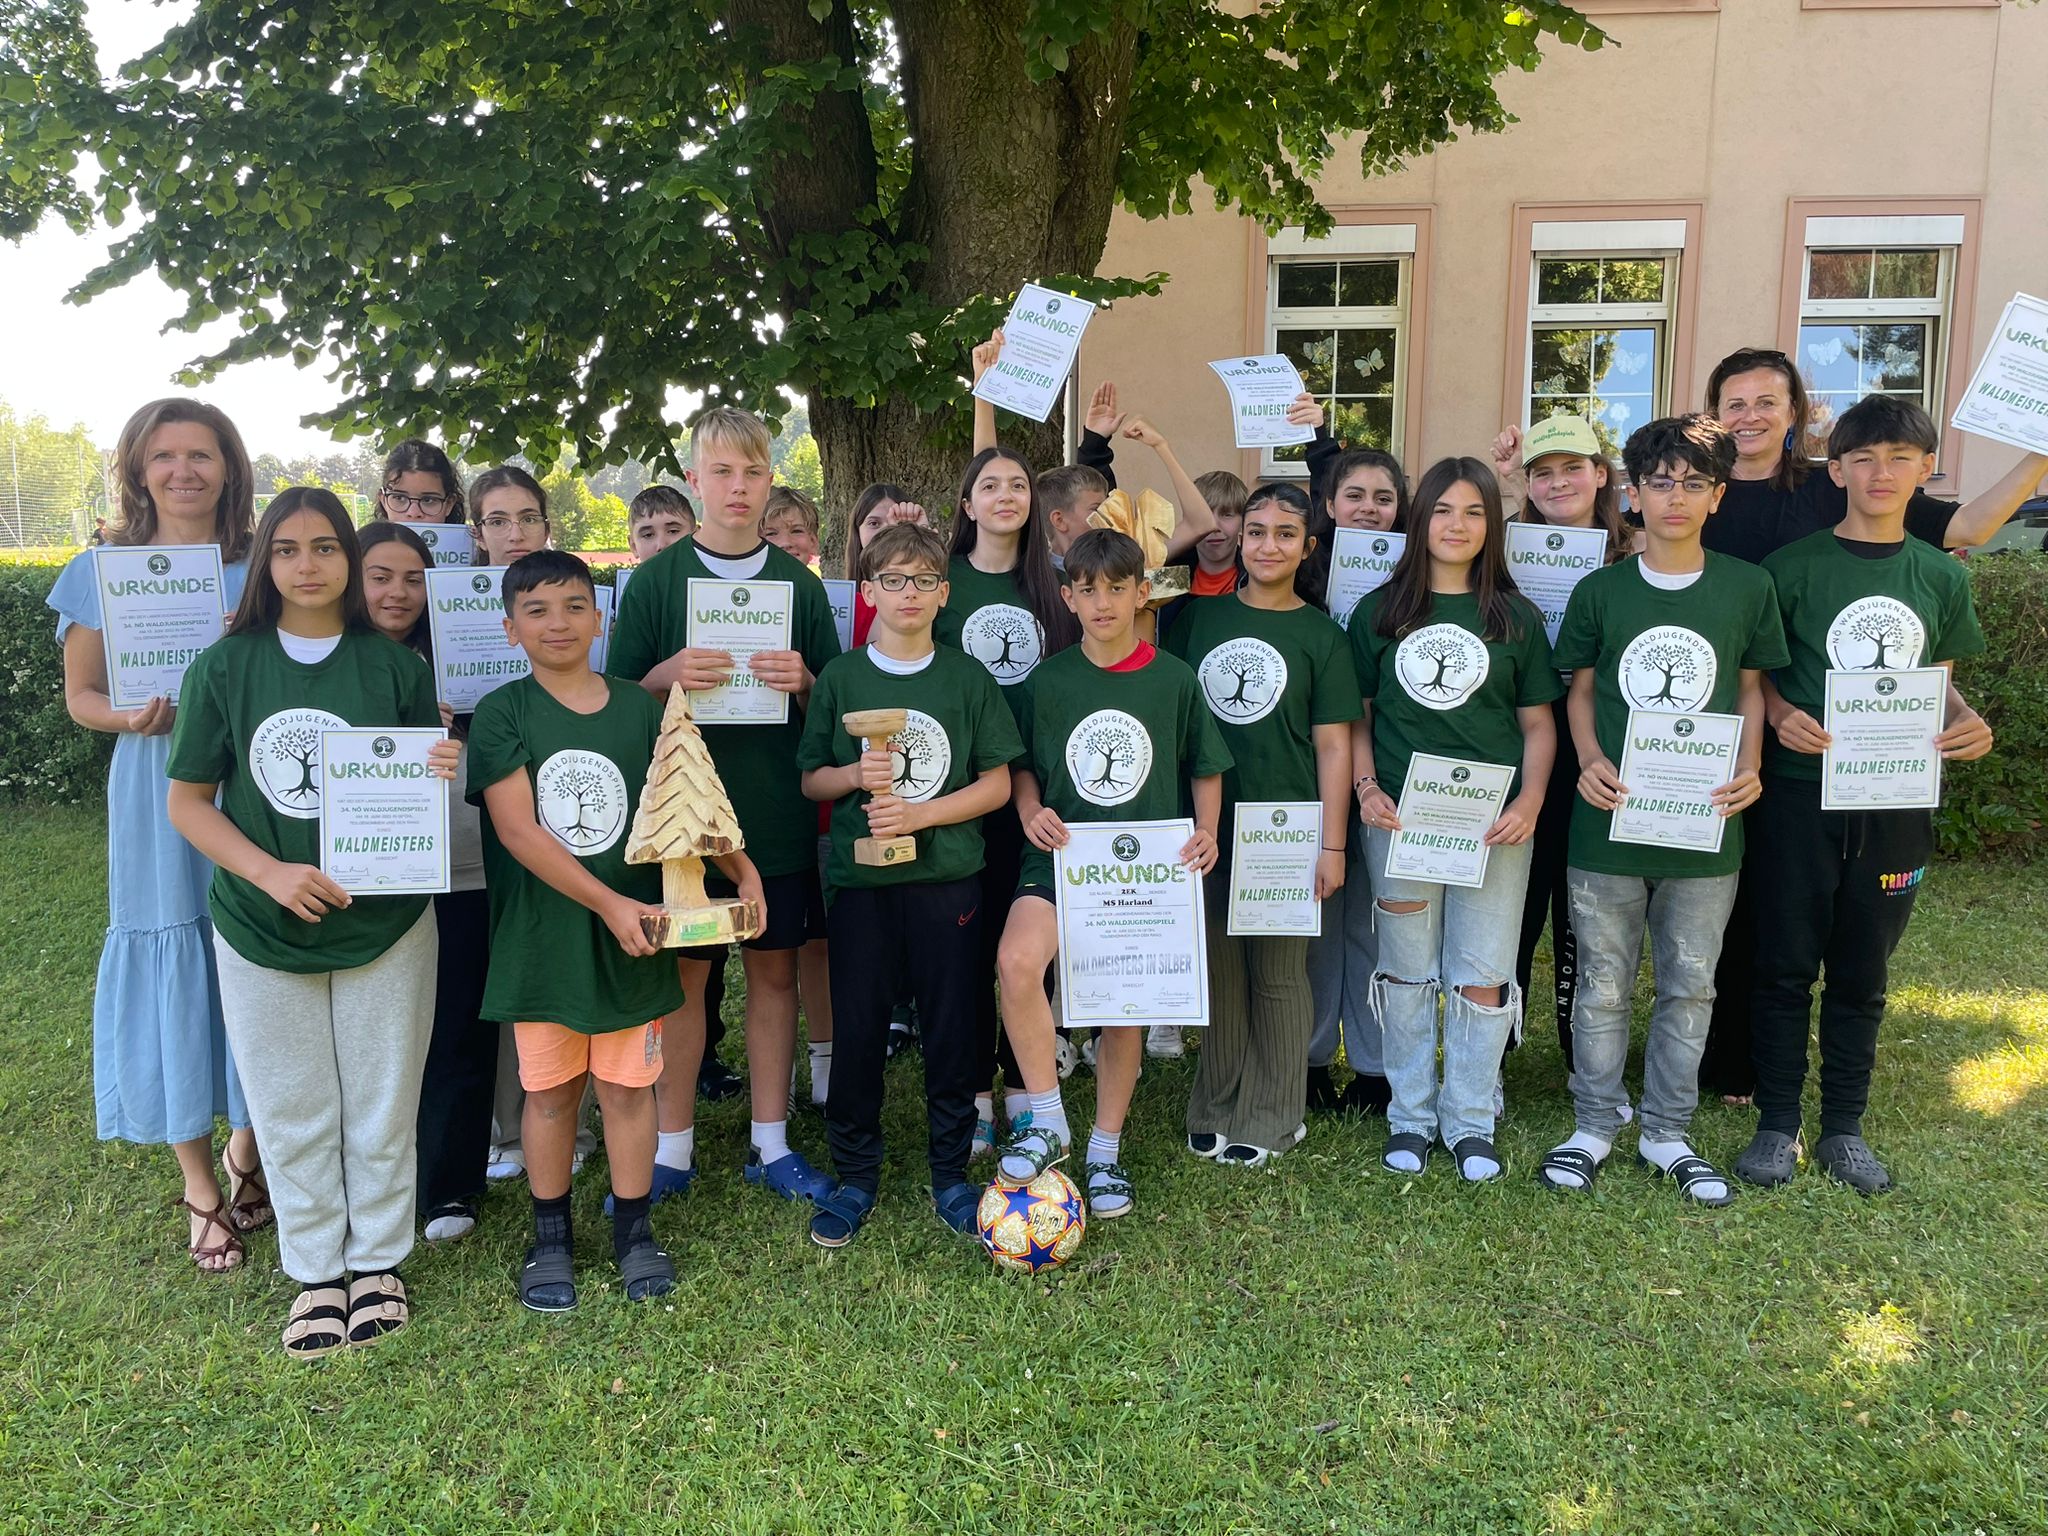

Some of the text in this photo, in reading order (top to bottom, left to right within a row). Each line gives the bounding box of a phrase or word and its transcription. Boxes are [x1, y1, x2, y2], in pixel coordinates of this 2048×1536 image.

[1016, 308, 1079, 337] URKUNDE
[995, 360, 1054, 389] WALDMEISTERS
[1224, 365, 1290, 376] URKUNDE
[1512, 551, 1597, 570] URKUNDE
[108, 578, 215, 596] URKUNDE
[696, 609, 784, 625] URKUNDE
[1840, 601, 1920, 649] WALDJUGENDSPIELE
[1408, 628, 1484, 670] WALDJUGENDSPIELE
[1631, 632, 1713, 678] WALDJUGENDSPIELE
[447, 659, 528, 677] WALDMEISTERS
[1211, 642, 1282, 685] WALDJUGENDSPIELE
[1835, 697, 1936, 713] URKUNDE
[1076, 715, 1149, 762] WALDJUGENDSPIELE
[1634, 737, 1730, 757] URKUNDE
[1835, 759, 1926, 775] WALDMEISTERS
[1413, 780, 1500, 801] URKUNDE
[1626, 796, 1713, 817] WALDMEISTERS
[334, 836, 434, 853] WALDMEISTERS
[1241, 830, 1316, 843] URKUNDE
[1401, 831, 1478, 853] WALDMEISTERS
[1067, 863, 1186, 885] URKUNDE
[1240, 888, 1310, 901] WALDMEISTERS
[1072, 953, 1192, 976] WALDMEISTERS IN SILBER
[1553, 1156, 1583, 1165] umbro
[1687, 1165, 1713, 1173] umbro
